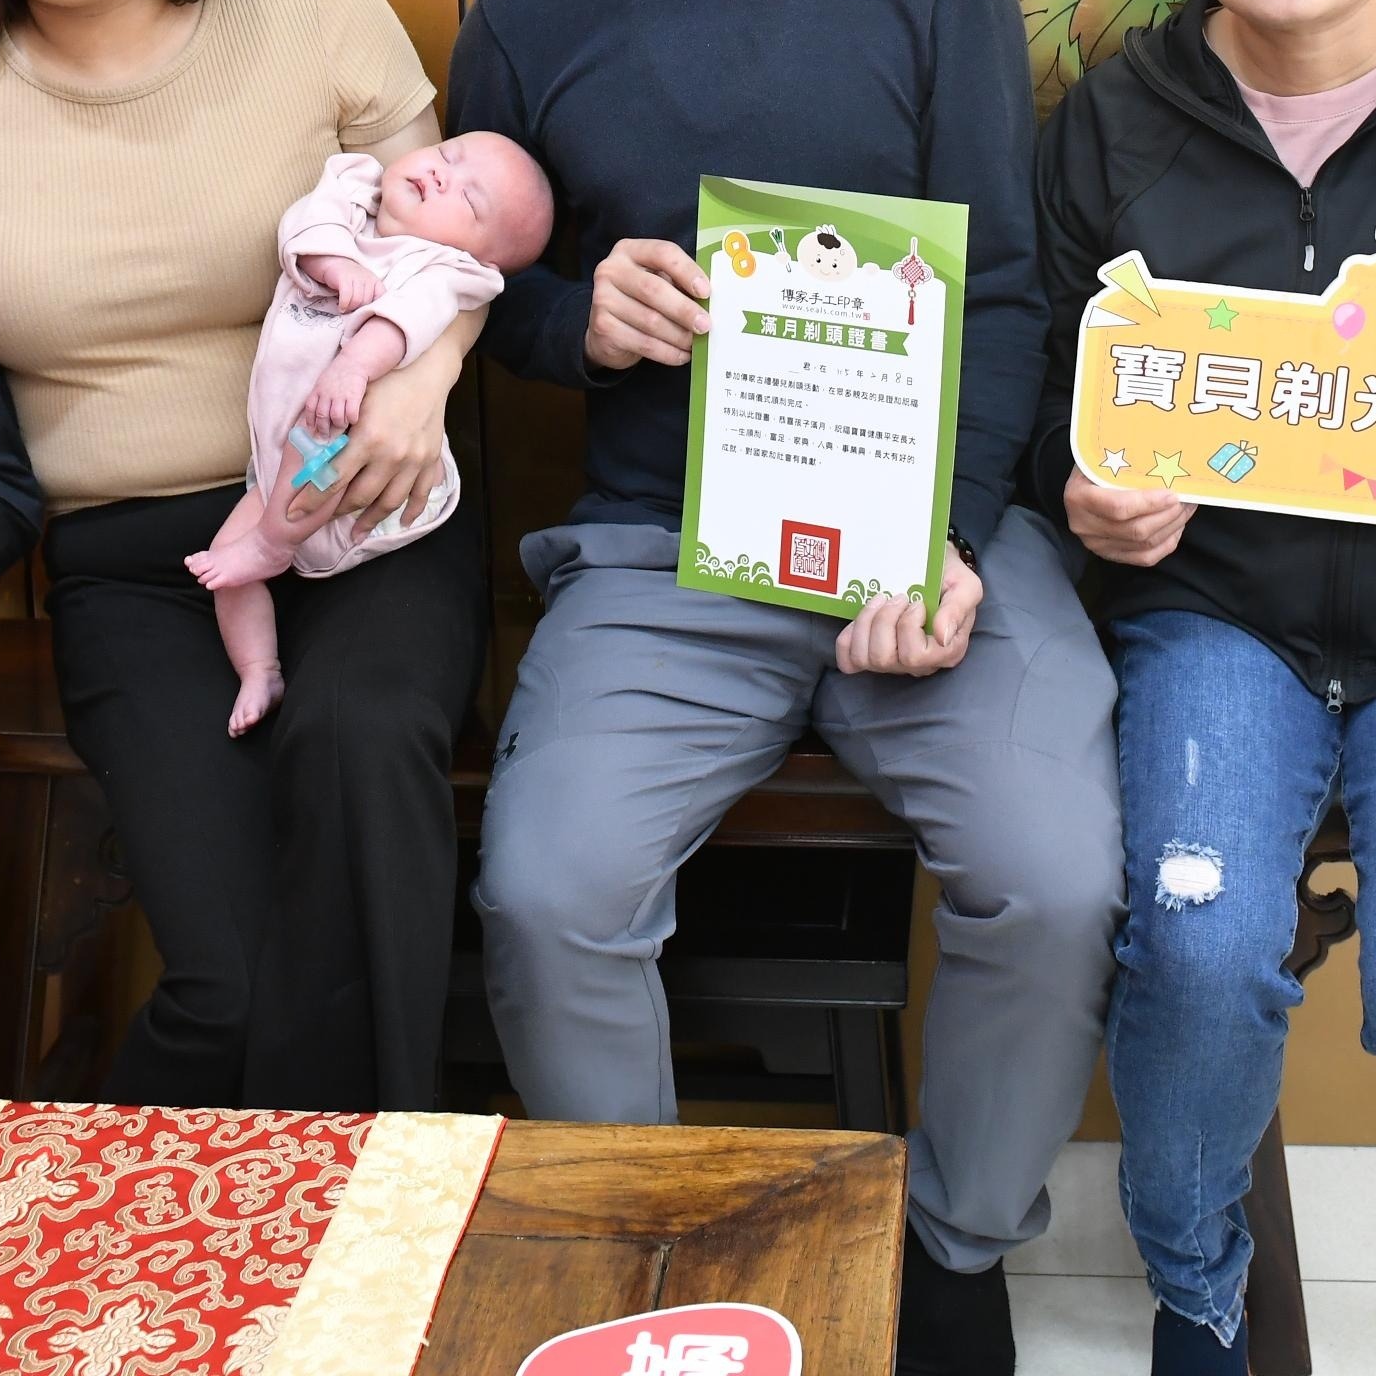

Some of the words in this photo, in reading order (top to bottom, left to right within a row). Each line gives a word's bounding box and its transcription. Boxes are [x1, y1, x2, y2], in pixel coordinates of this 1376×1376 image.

[781, 288, 865, 311] 傳家手工印章
[782, 302, 862, 319] www.seals.com.tw
[760, 314, 888, 352] 滿月剃頭證書
[856, 370, 864, 379] 年
[881, 373, 889, 382] 月
[906, 376, 913, 385] 日
